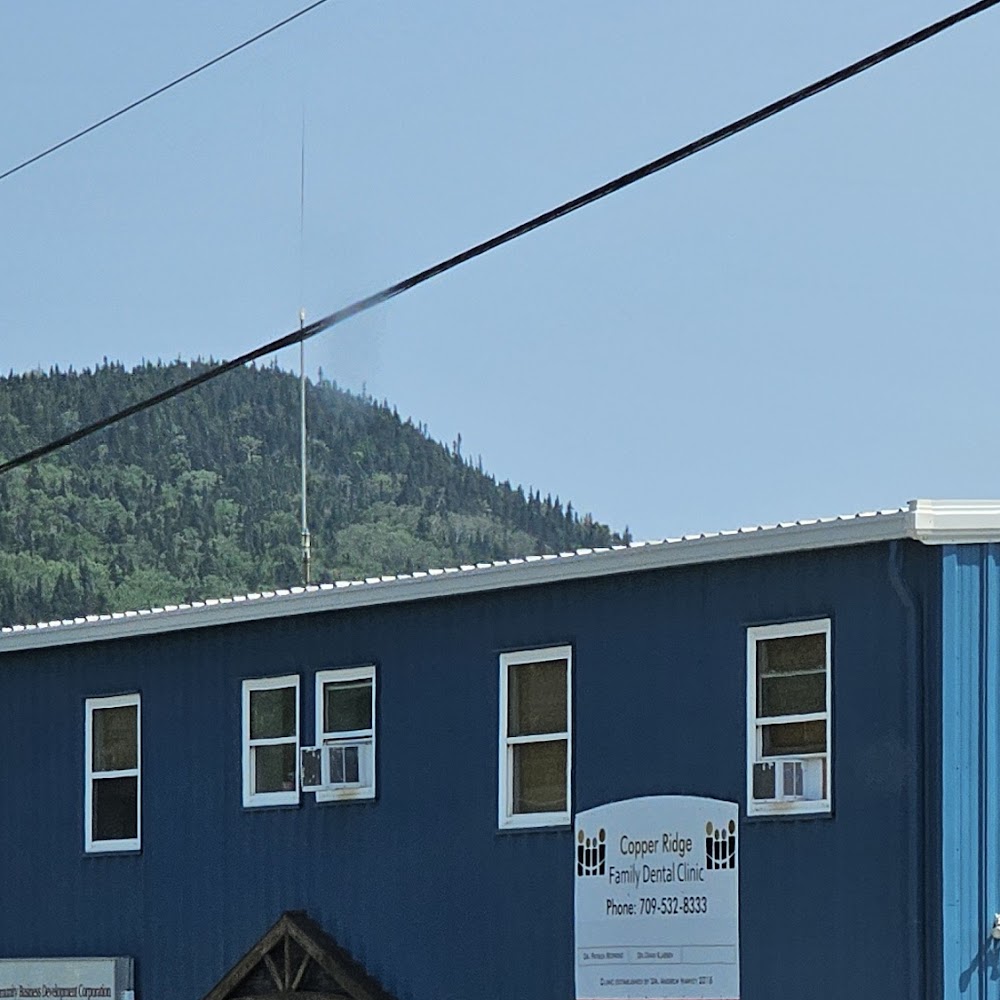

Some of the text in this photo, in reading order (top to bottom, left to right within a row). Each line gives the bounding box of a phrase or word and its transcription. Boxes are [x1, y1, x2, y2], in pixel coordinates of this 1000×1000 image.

[620, 833, 692, 858] Copper Ridge
[609, 863, 704, 889] Family Dental Clinic
[607, 897, 707, 915] Phone: 709-532-8333
